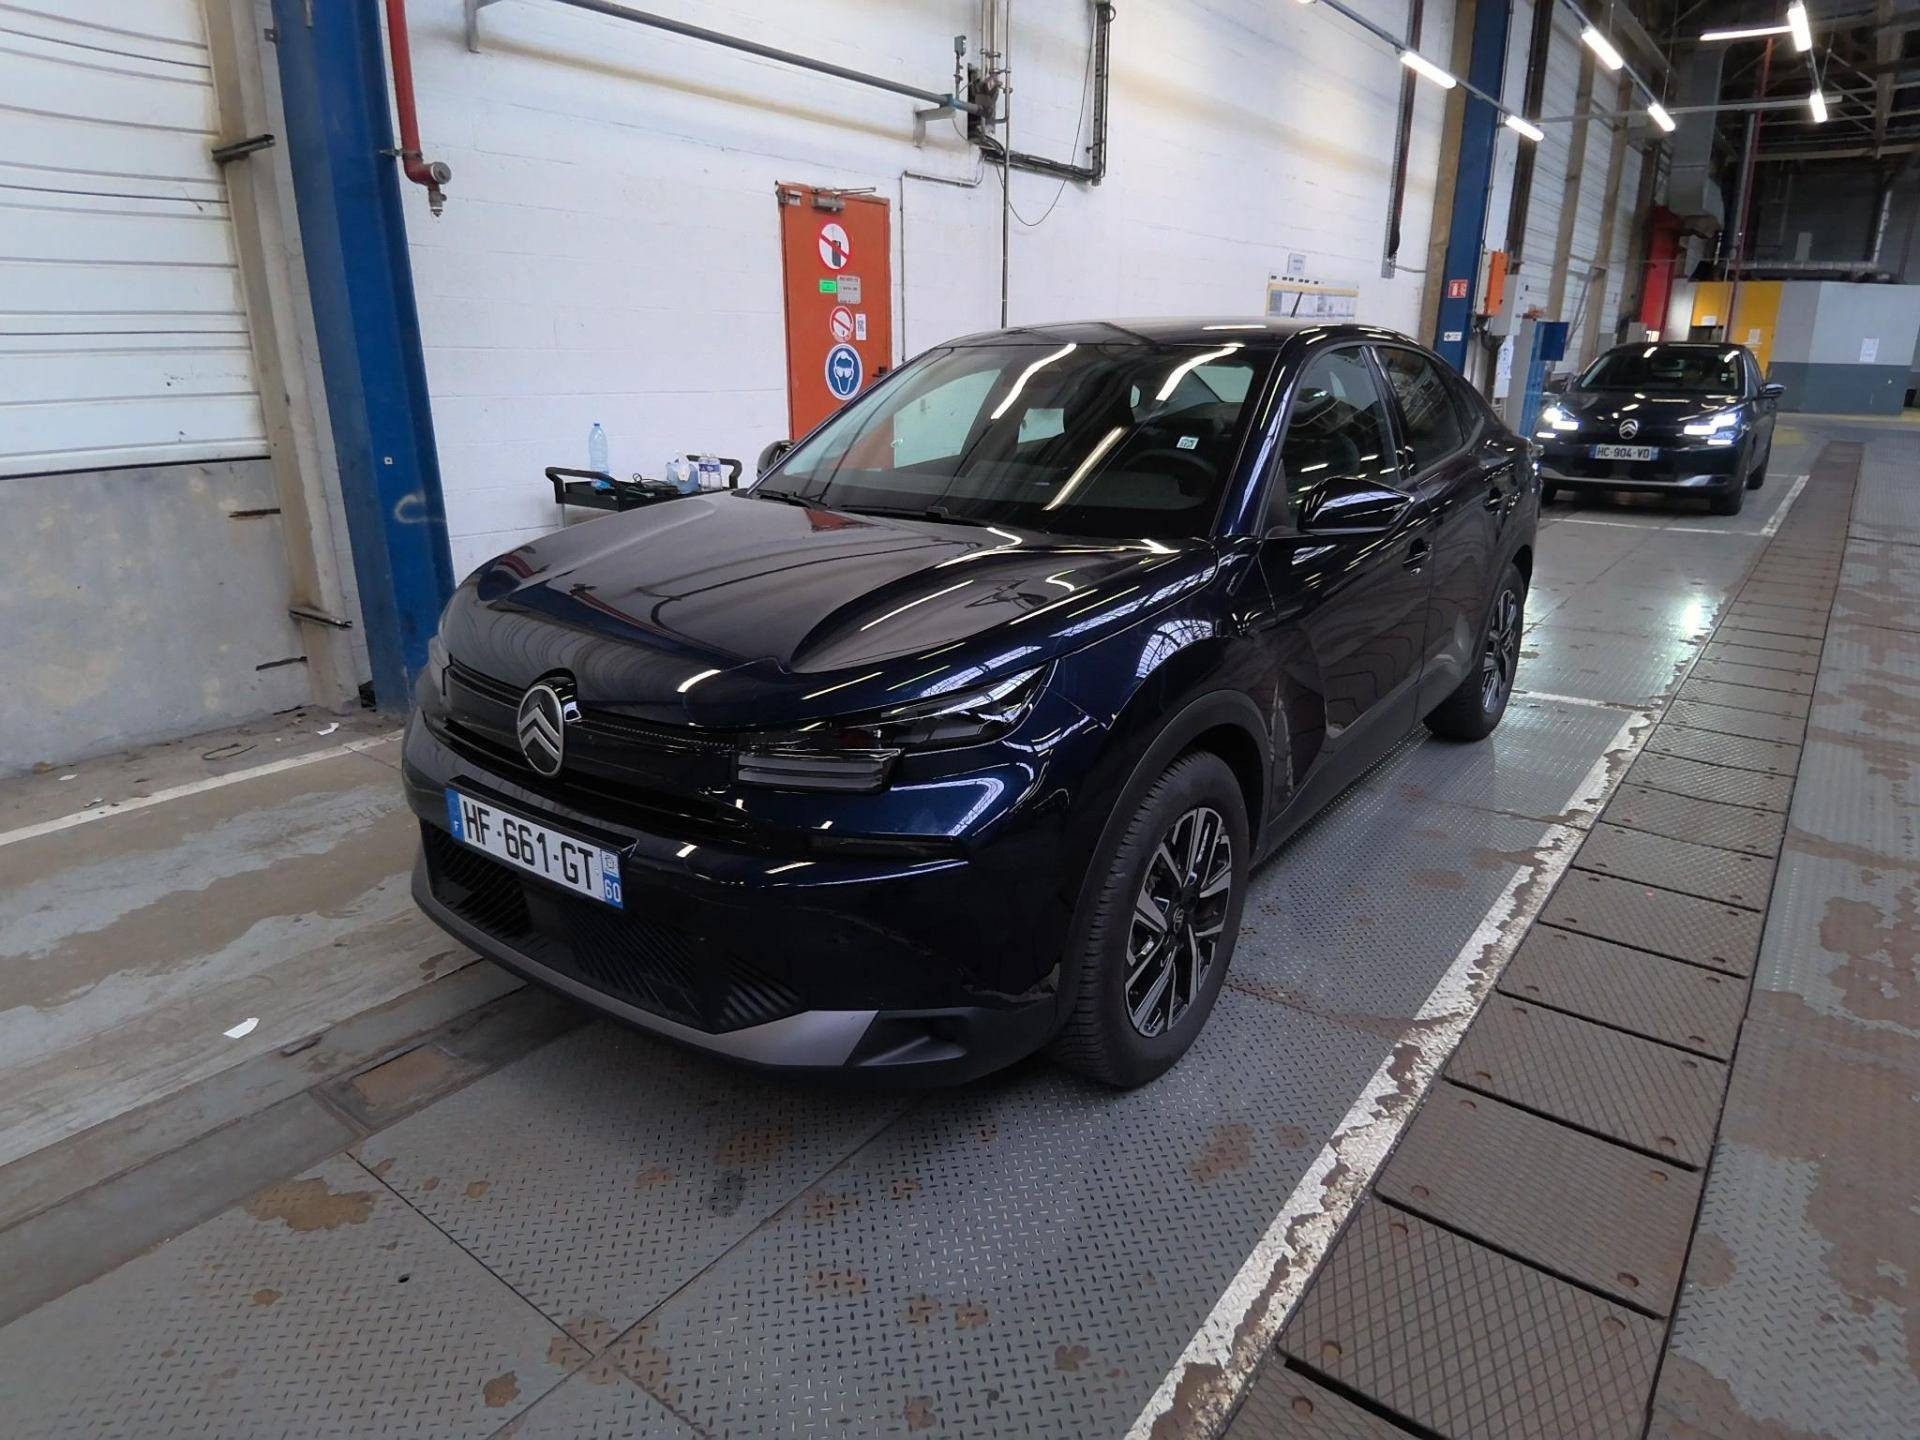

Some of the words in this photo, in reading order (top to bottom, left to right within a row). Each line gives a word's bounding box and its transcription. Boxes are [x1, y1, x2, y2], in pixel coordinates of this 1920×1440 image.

[453, 820, 460, 832] F
[463, 801, 594, 890] HF-661-GT
[604, 879, 622, 902] 60
